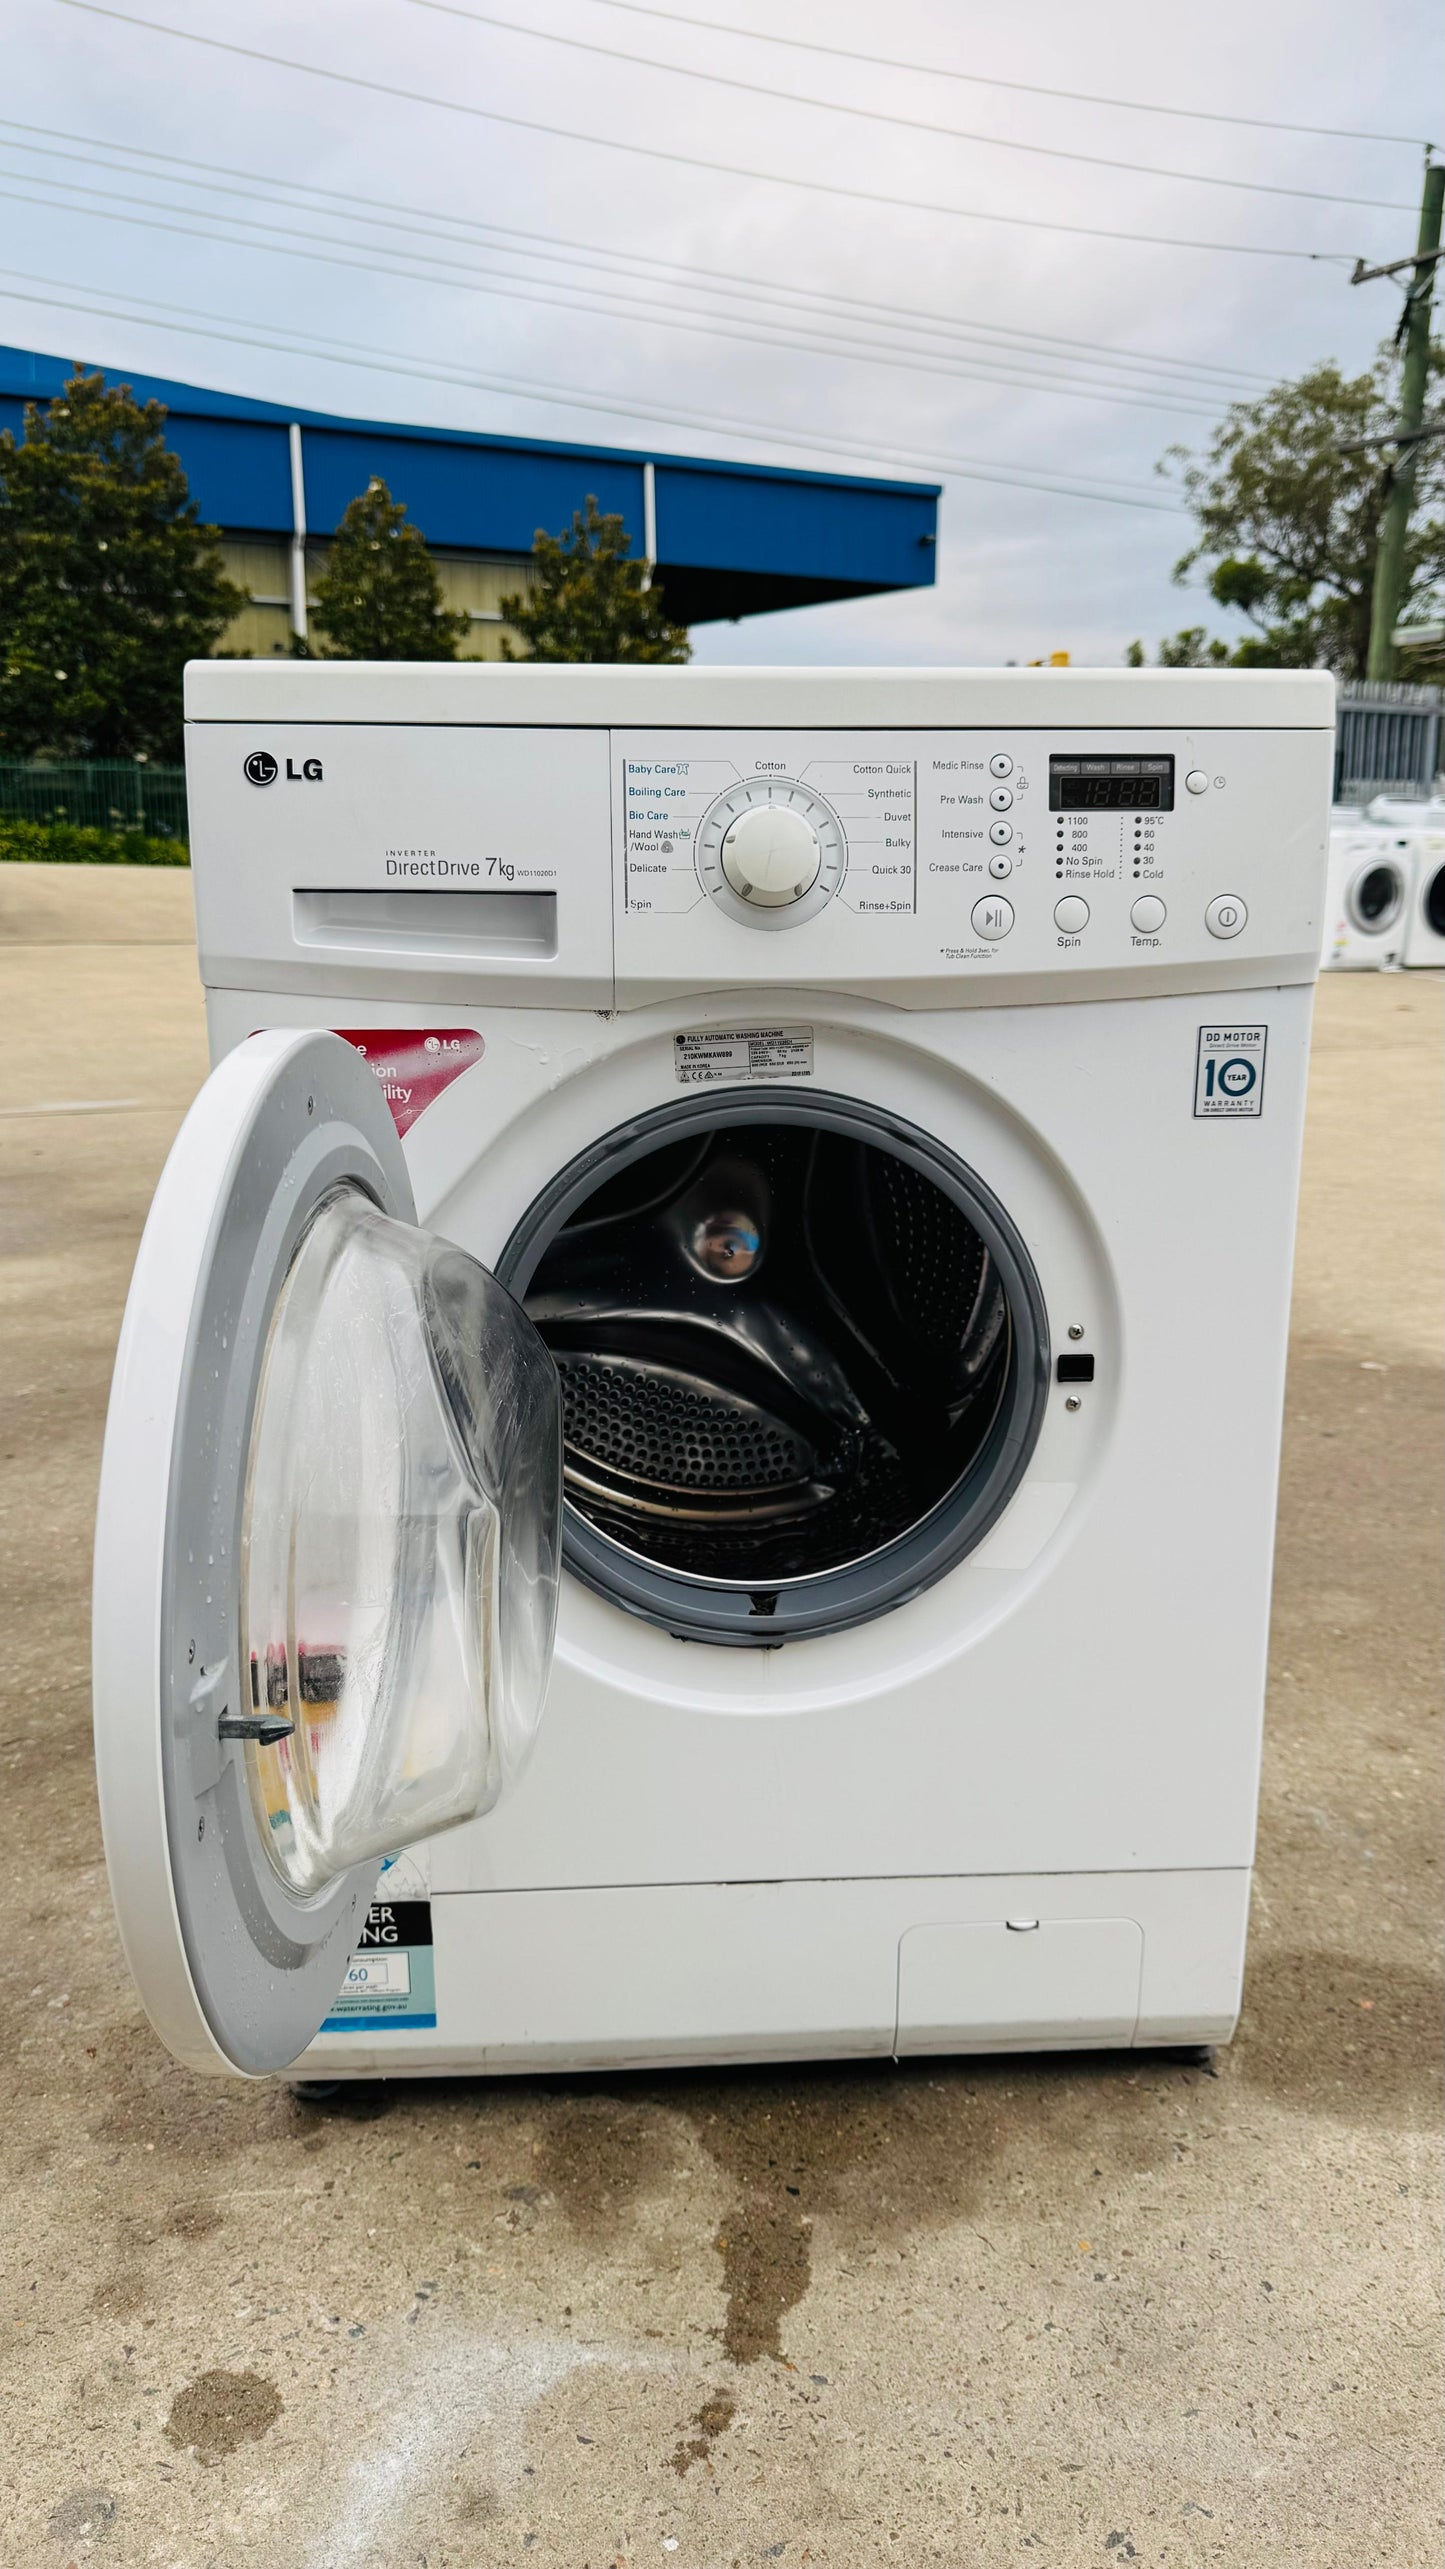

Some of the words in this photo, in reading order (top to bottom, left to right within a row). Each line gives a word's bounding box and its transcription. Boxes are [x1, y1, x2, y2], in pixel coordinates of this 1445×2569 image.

[286, 758, 323, 781] LG
[628, 764, 652, 775] Baby
[654, 764, 676, 774] Care
[755, 761, 786, 771] Cotton
[853, 764, 885, 774] Cotton
[887, 764, 911, 775] Quick
[932, 760, 957, 770] Medic
[959, 760, 984, 770] Rinse
[1147, 763, 1164, 772] Spin
[628, 787, 662, 798] Boiling
[664, 787, 686, 797] Care
[867, 788, 911, 799] Synthetic
[940, 795, 955, 804] Pre
[957, 794, 984, 804] Wash
[629, 811, 644, 820] Bio
[646, 811, 669, 820] Care
[884, 812, 911, 822] Duvet
[1067, 816, 1088, 825] 1100
[629, 829, 651, 839] Hand
[653, 829, 678, 839] Wash
[941, 829, 984, 839] Intensive
[1071, 829, 1088, 839] 800
[1144, 829, 1155, 839] 60
[630, 841, 659, 852] /Wool
[885, 837, 911, 848] Bulky
[1071, 843, 1088, 852] 400
[1143, 843, 1155, 852] 40
[1066, 856, 1079, 866] No
[1081, 856, 1103, 867] Spin
[1143, 856, 1155, 865] 30
[629, 863, 667, 873] Delicate
[871, 864, 897, 875] Quick
[899, 865, 911, 874] 30
[929, 863, 961, 873] Crease
[962, 863, 983, 873] Care
[1065, 869, 1089, 879] Rinse
[1090, 869, 1115, 879] Hold
[1142, 869, 1164, 879] Cold
[630, 899, 652, 909] Spin
[859, 900, 911, 911] Rinse+Spin
[1057, 936, 1081, 949] Spin
[1131, 936, 1162, 949] Temp.
[687, 1035, 704, 1043] FULLY
[704, 1033, 735, 1041] AUTOMATIC
[735, 1032, 760, 1040] WASHING
[760, 1030, 784, 1038] MACHINE
[1206, 1033, 1220, 1042] DD
[1223, 1032, 1260, 1042] MOTOR
[443, 1039, 460, 1050] LG
[1205, 1058, 1256, 1097] 10
